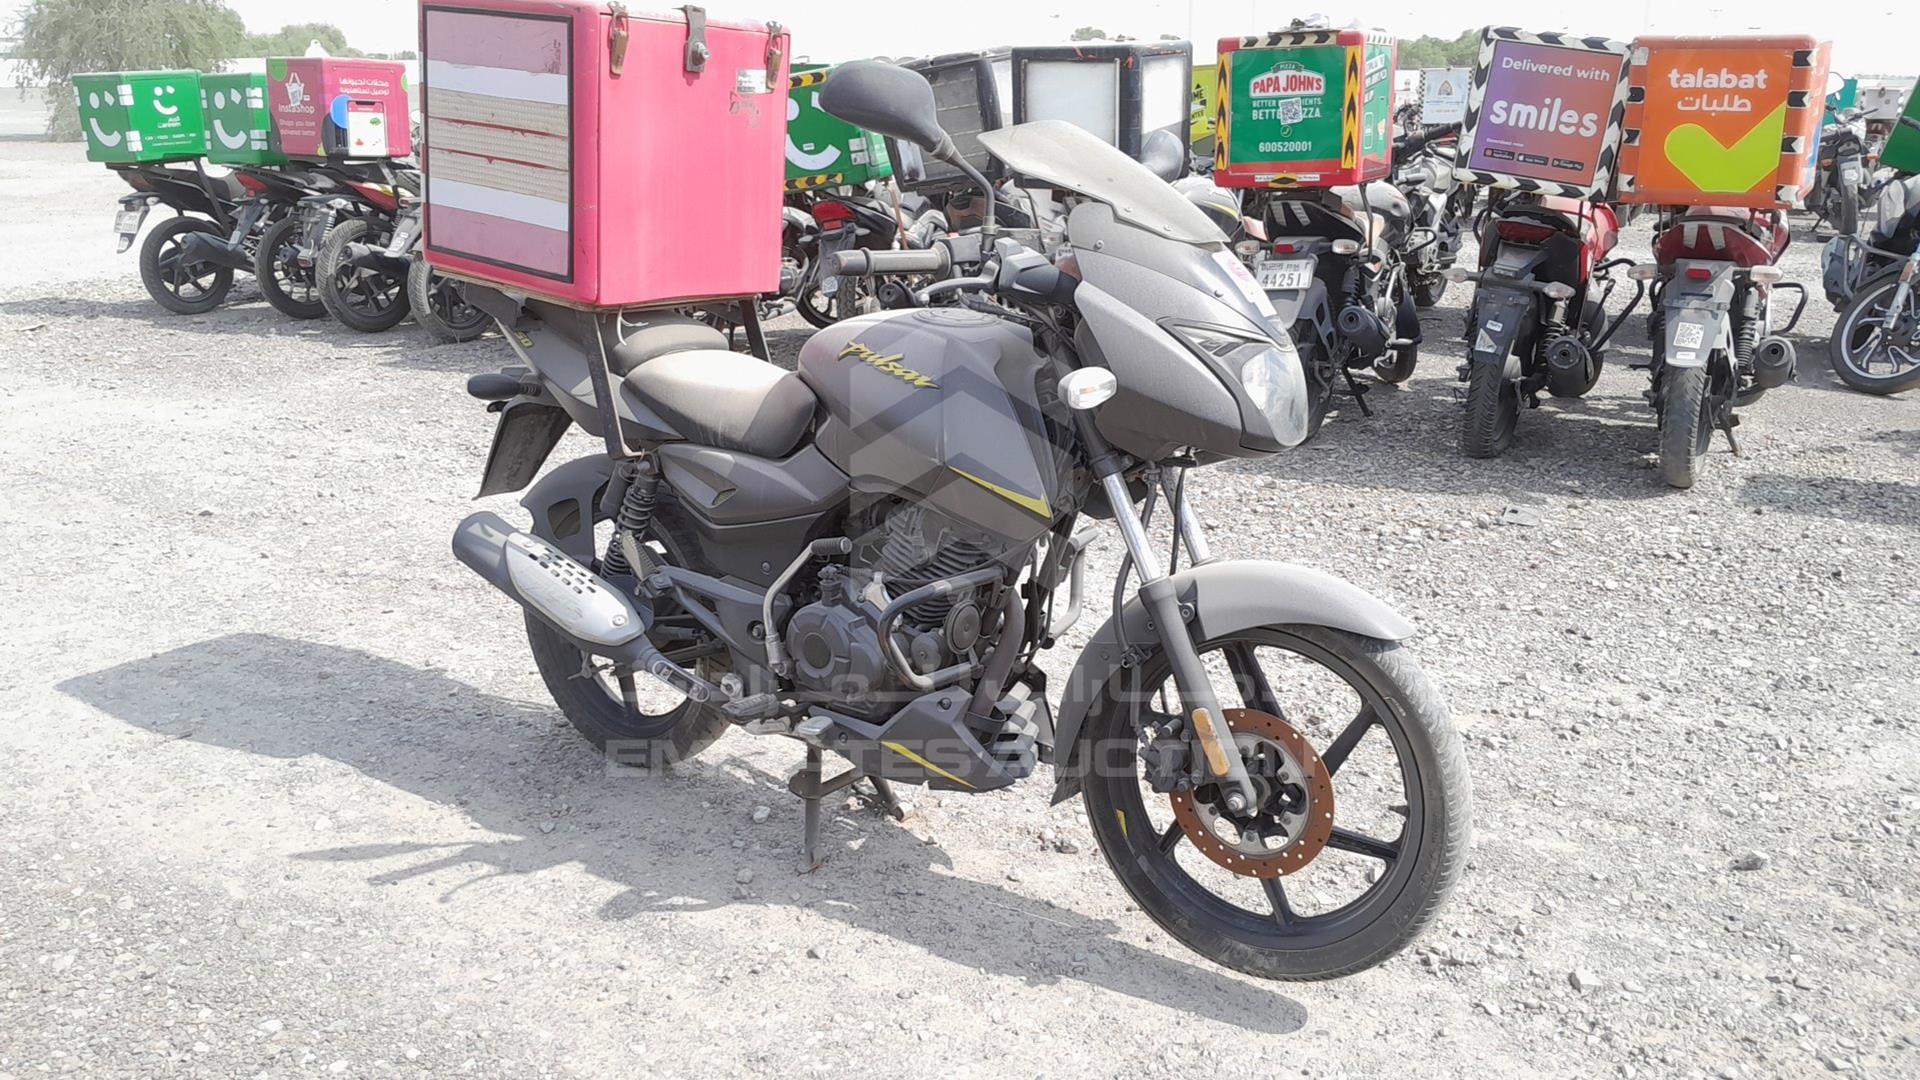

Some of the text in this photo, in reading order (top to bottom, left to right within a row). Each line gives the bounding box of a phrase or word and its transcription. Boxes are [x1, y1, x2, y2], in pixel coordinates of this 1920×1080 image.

[1501, 56, 1610, 82] Delivered with
[1252, 76, 1280, 94] PAPA
[1667, 67, 1769, 89] talabat
[278, 103, 315, 115] InstaShop
[1252, 99, 1277, 108] BETTER
[1676, 94, 1752, 117] طلبات
[1252, 108, 1282, 120] BETTE
[1489, 97, 1599, 138] smiles
[1258, 141, 1312, 153] 600520001
[1262, 272, 1301, 288] 44251
